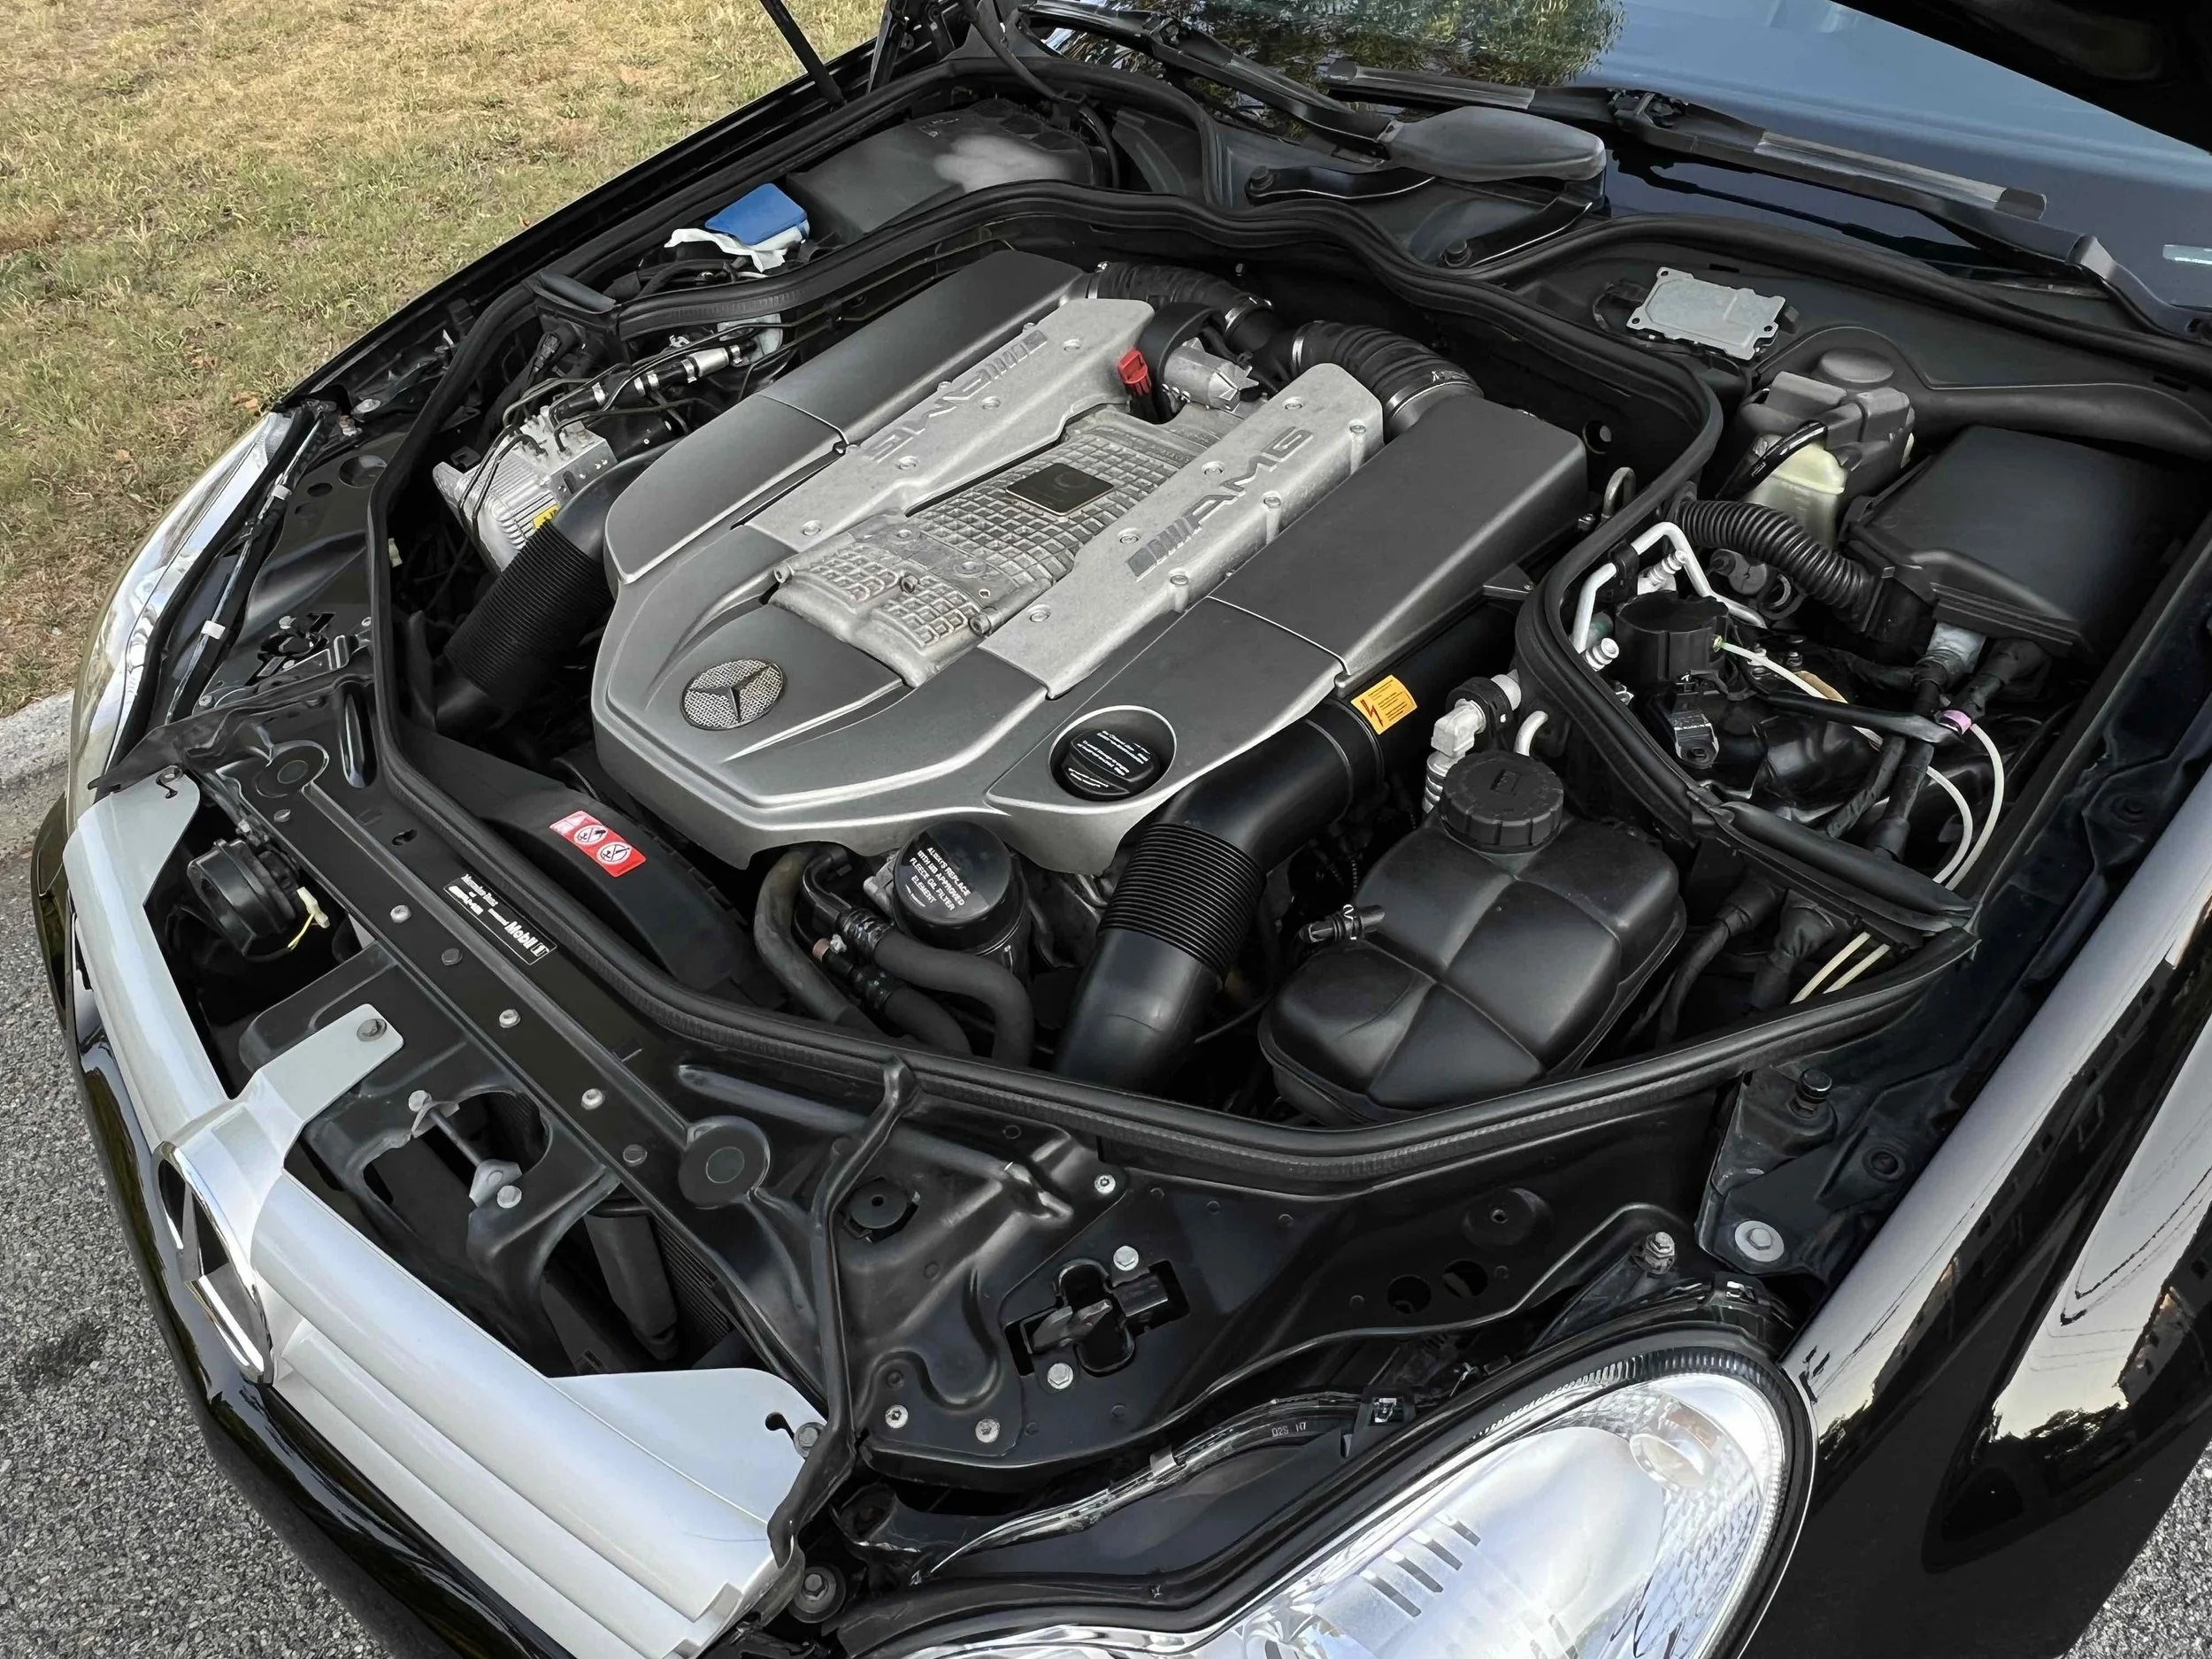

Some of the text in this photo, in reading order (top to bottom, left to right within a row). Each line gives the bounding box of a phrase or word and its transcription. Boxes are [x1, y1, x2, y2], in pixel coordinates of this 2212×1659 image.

[910, 857, 930, 879] FLEECE
[935, 887, 956, 910] FILTER
[911, 875, 937, 902] ELEMENT
[917, 850, 931, 865] WITH
[934, 872, 965, 906] APPROVED
[926, 847, 971, 896] ALWAYS REPLACE
[504, 921, 538, 949] Mobil
